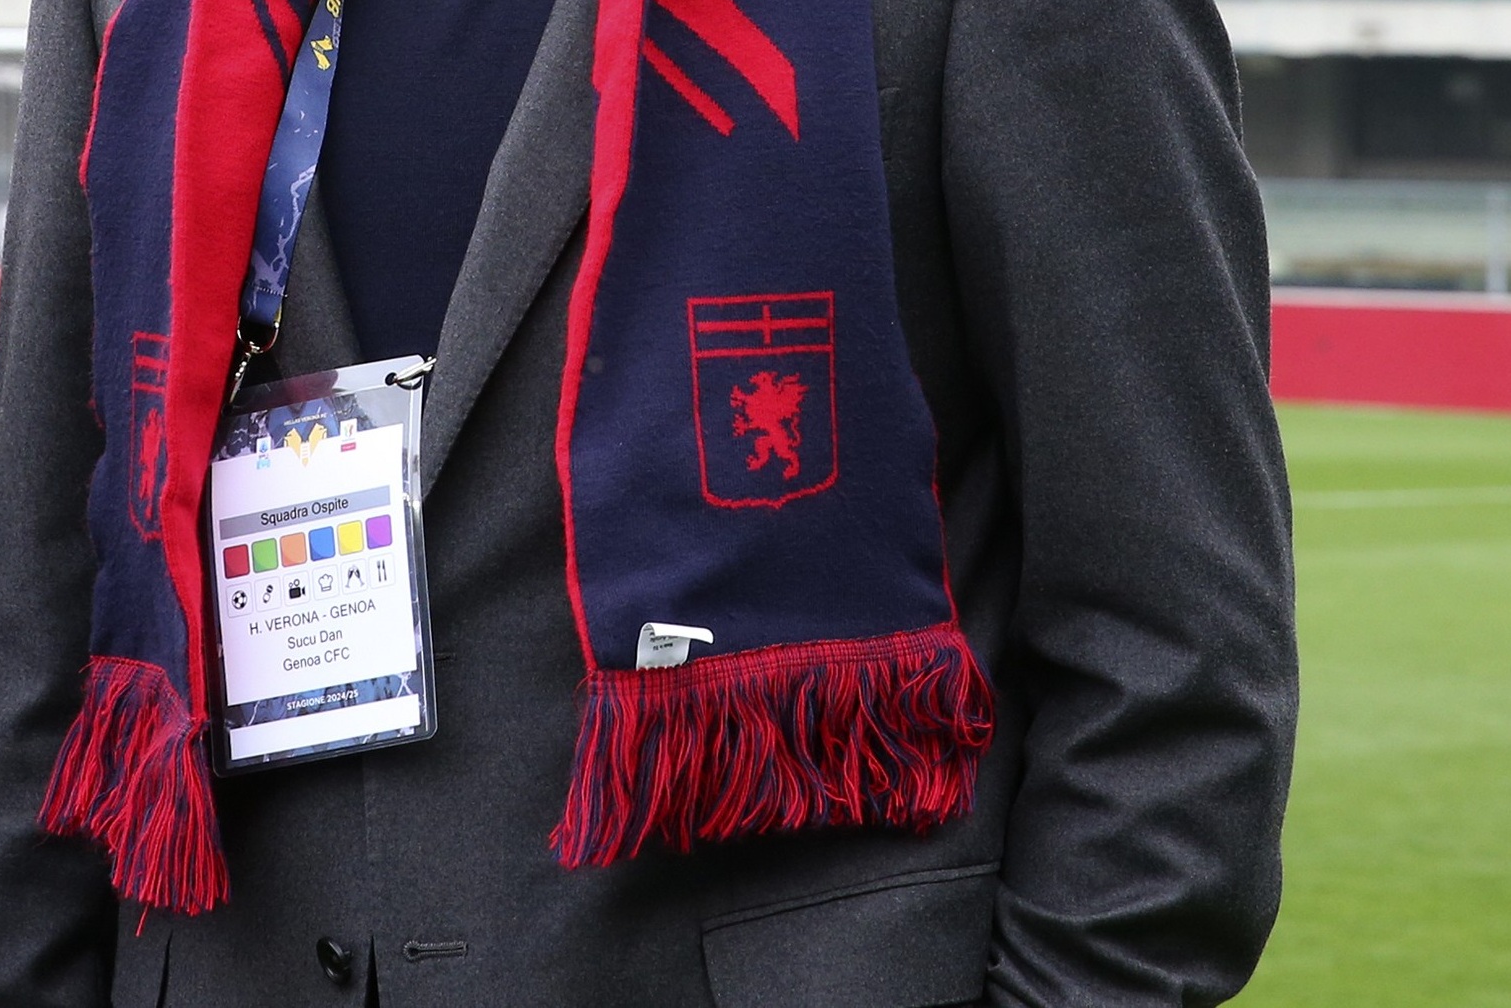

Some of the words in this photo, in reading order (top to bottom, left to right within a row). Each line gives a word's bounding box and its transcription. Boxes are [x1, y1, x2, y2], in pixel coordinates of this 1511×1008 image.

[260, 504, 308, 526] Squadra
[312, 497, 349, 517] Ospite
[249, 621, 262, 636] H.
[266, 610, 319, 633] VERONA
[330, 599, 376, 621] GENOA
[287, 634, 316, 650] Sucu
[320, 628, 343, 643] Dan
[283, 651, 321, 672] Genoa
[323, 647, 350, 663] CFC
[287, 695, 325, 710] STAGIONE
[327, 689, 359, 702] 2024/25
